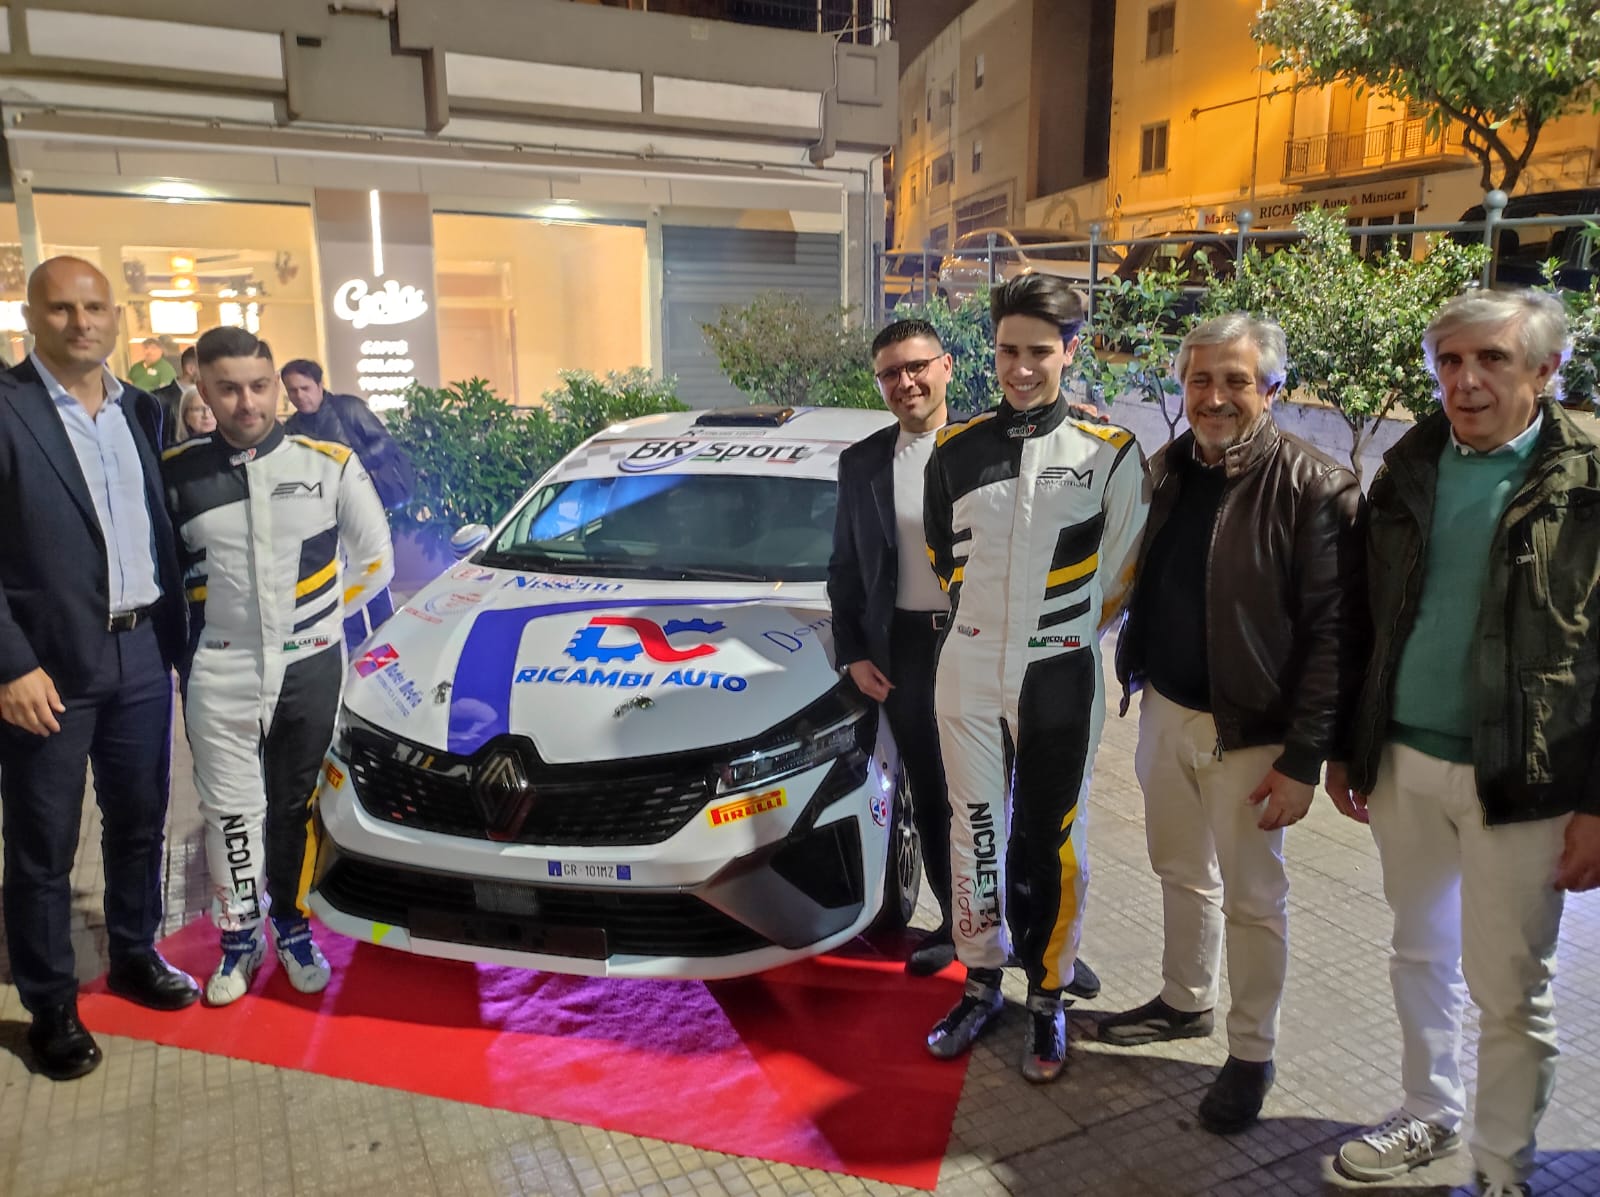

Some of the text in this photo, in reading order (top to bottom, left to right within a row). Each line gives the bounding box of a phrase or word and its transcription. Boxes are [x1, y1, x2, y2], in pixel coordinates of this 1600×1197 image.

[1204, 211, 1239, 225] March
[1259, 200, 1316, 219] RICAMB
[1361, 190, 1407, 205] Minicar
[627, 440, 810, 463] BR Sport
[515, 666, 748, 692] RICAMBI AUTO
[710, 790, 783, 825] PIRELLI
